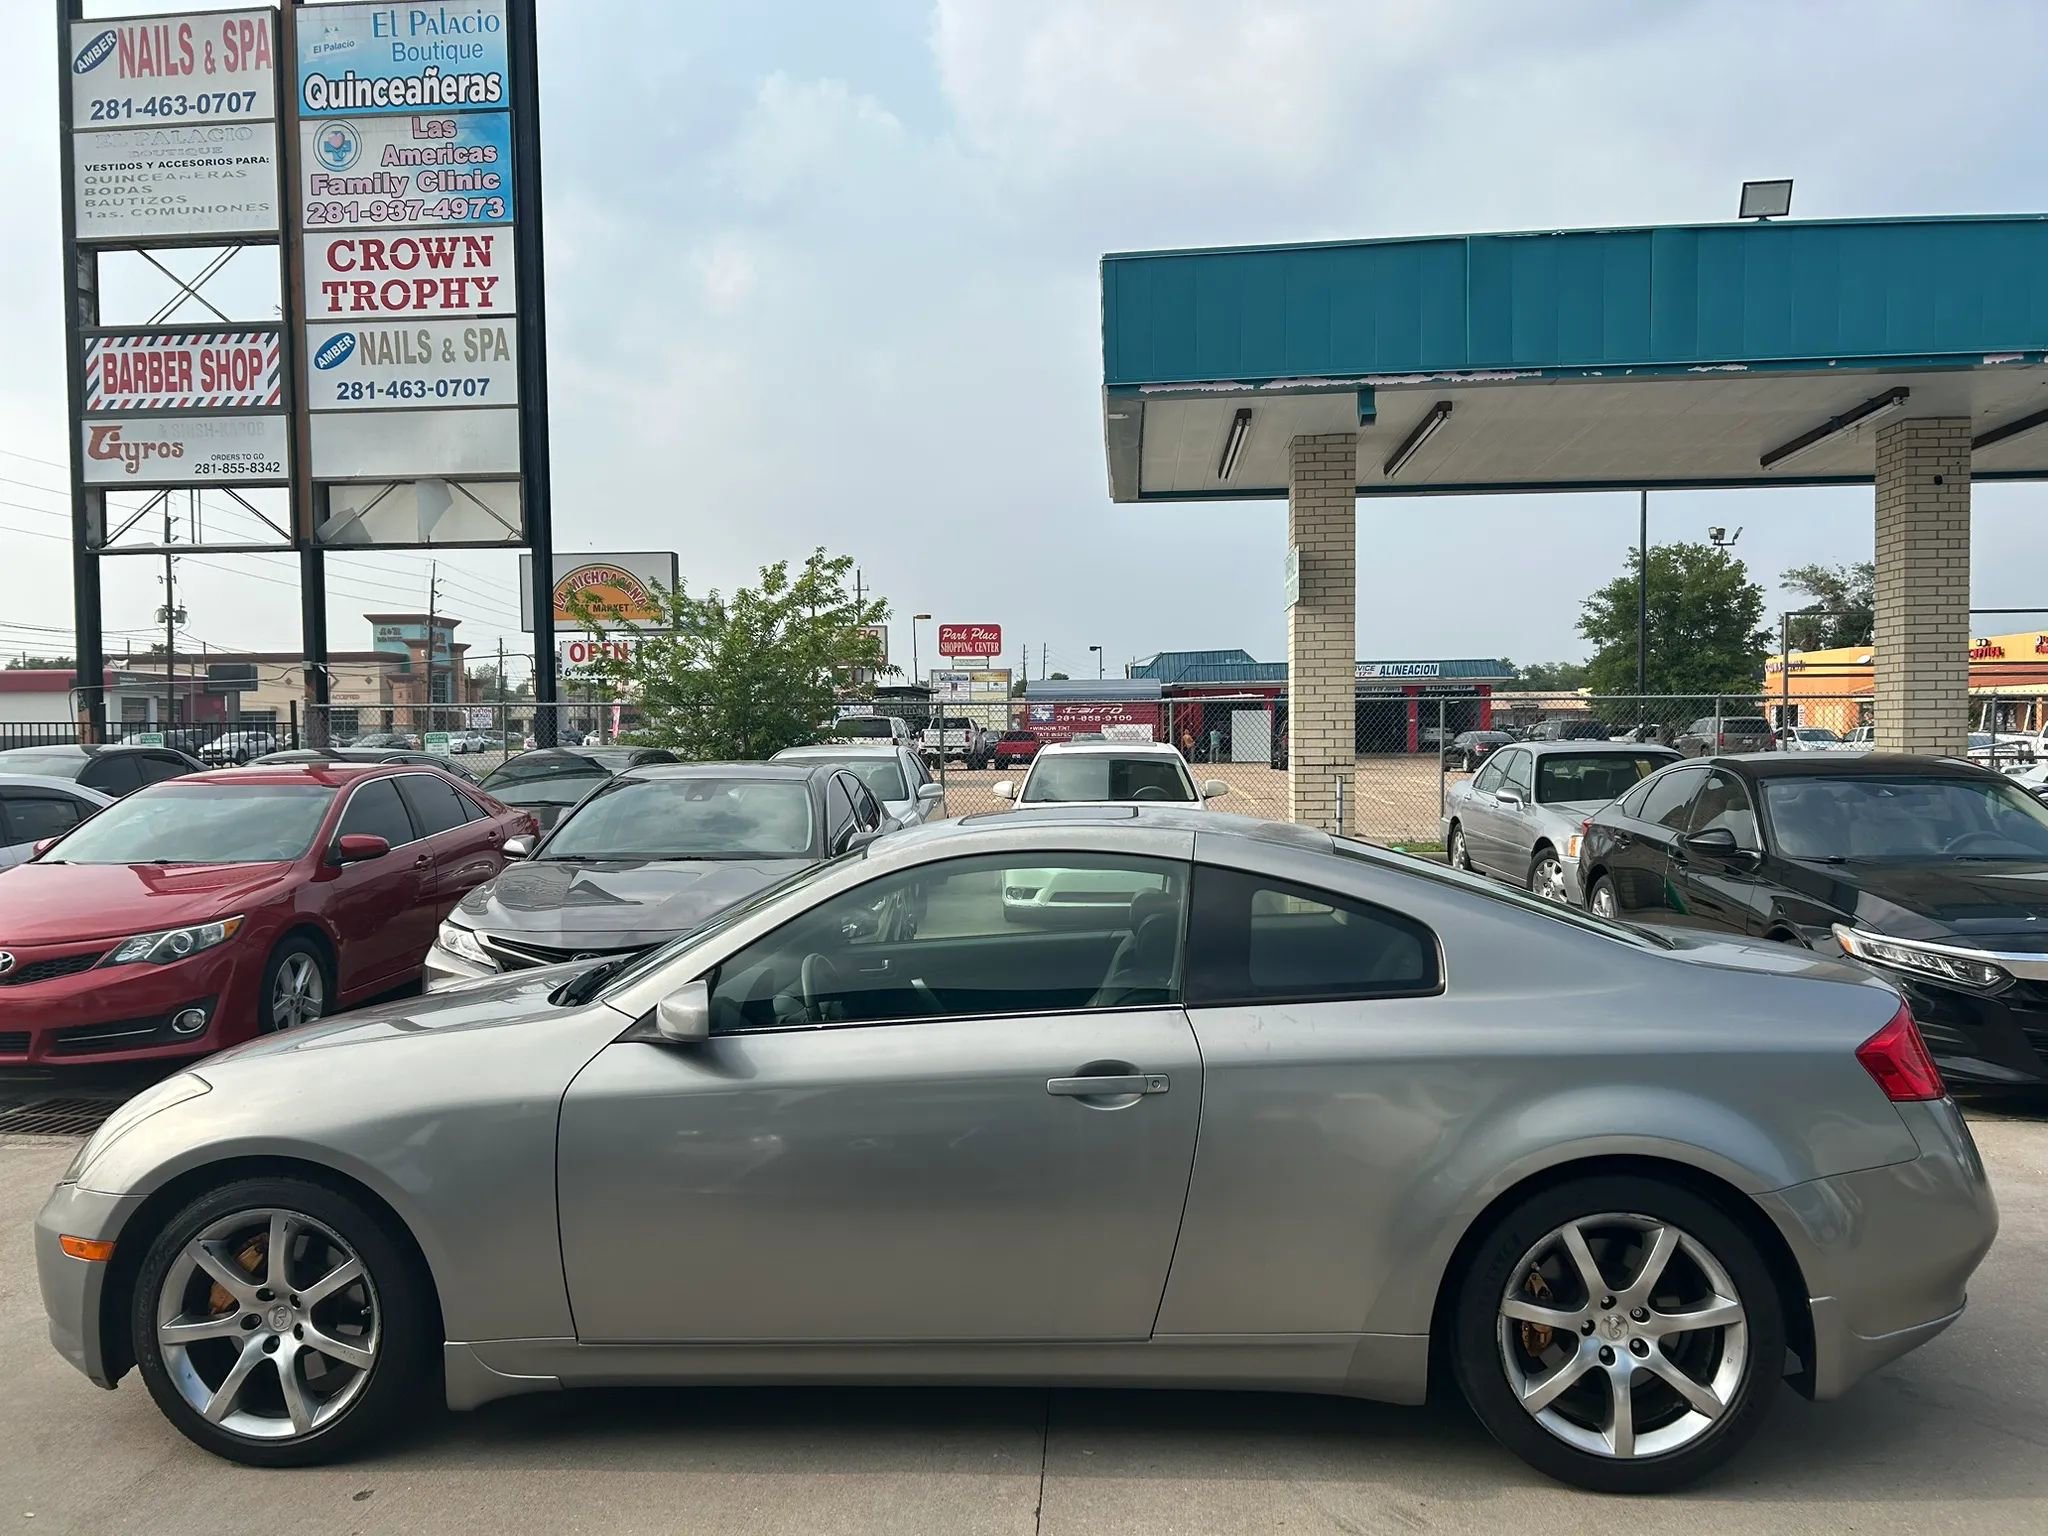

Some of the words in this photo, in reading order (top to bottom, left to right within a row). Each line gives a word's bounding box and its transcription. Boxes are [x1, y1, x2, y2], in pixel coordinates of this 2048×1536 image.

[372, 10, 399, 38] El
[76, 31, 116, 72] AMBER
[117, 22, 195, 79] NAILS
[204, 40, 216, 75] &
[223, 18, 272, 72] SPA
[313, 46, 321, 54] El
[323, 40, 355, 53] Palacio
[392, 40, 484, 64] Boutique
[304, 65, 502, 111] Quinceañeras
[90, 91, 257, 120] 281-463-0707
[134, 126, 253, 146] PALACIO
[411, 116, 457, 140] Las
[85, 162, 142, 171] VESTIDOS
[158, 158, 233, 168] ACCESORIOS
[236, 156, 270, 164] PARA:
[129, 147, 223, 158] BOUTIQUE
[381, 142, 498, 167] Americas
[84, 170, 247, 184] QUINCEAÑERAS
[310, 172, 409, 198] Family
[416, 169, 501, 193] Clinic
[84, 185, 153, 196] BODAS
[85, 195, 188, 207] BAUTIZOS
[131, 202, 270, 217] COMUNIONES
[307, 197, 505, 224] 281-937-4973
[326, 235, 495, 273] CROWN
[322, 276, 499, 312] TROPHY
[317, 334, 354, 369] AMBER
[359, 329, 432, 366] NAILS
[442, 338, 456, 364] &
[463, 327, 510, 363] SPA
[102, 350, 193, 395] BARBER
[200, 348, 263, 393] SHOP
[336, 378, 490, 400] 281-463-0707
[88, 425, 184, 475] Gyros
[194, 461, 280, 475] 281-855-8342
[942, 628, 968, 640] Park
[971, 628, 998, 640] Place
[941, 642, 972, 652] SHOPPING
[975, 642, 999, 652] CENTER
[1380, 665, 1438, 675] ALINEACION
